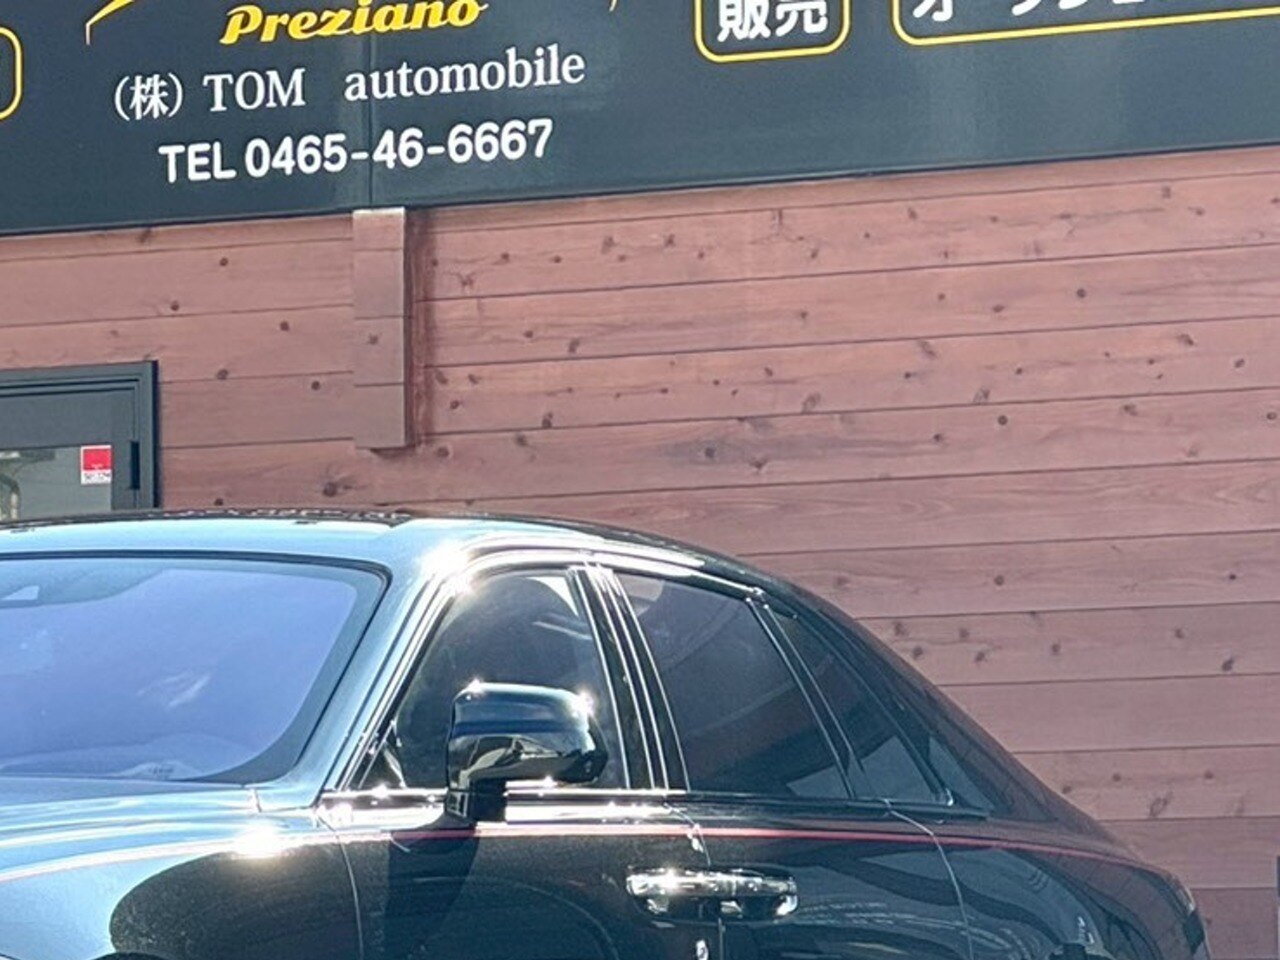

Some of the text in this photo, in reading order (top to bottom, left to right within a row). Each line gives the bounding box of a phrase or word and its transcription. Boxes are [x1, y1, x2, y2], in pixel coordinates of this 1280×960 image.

[220, 0, 488, 44] Preziano
[718, 0, 827, 42] 販売
[203, 69, 305, 112] TOM
[344, 43, 585, 102] automobile
[158, 118, 553, 183] TEL 0465-46-6667
